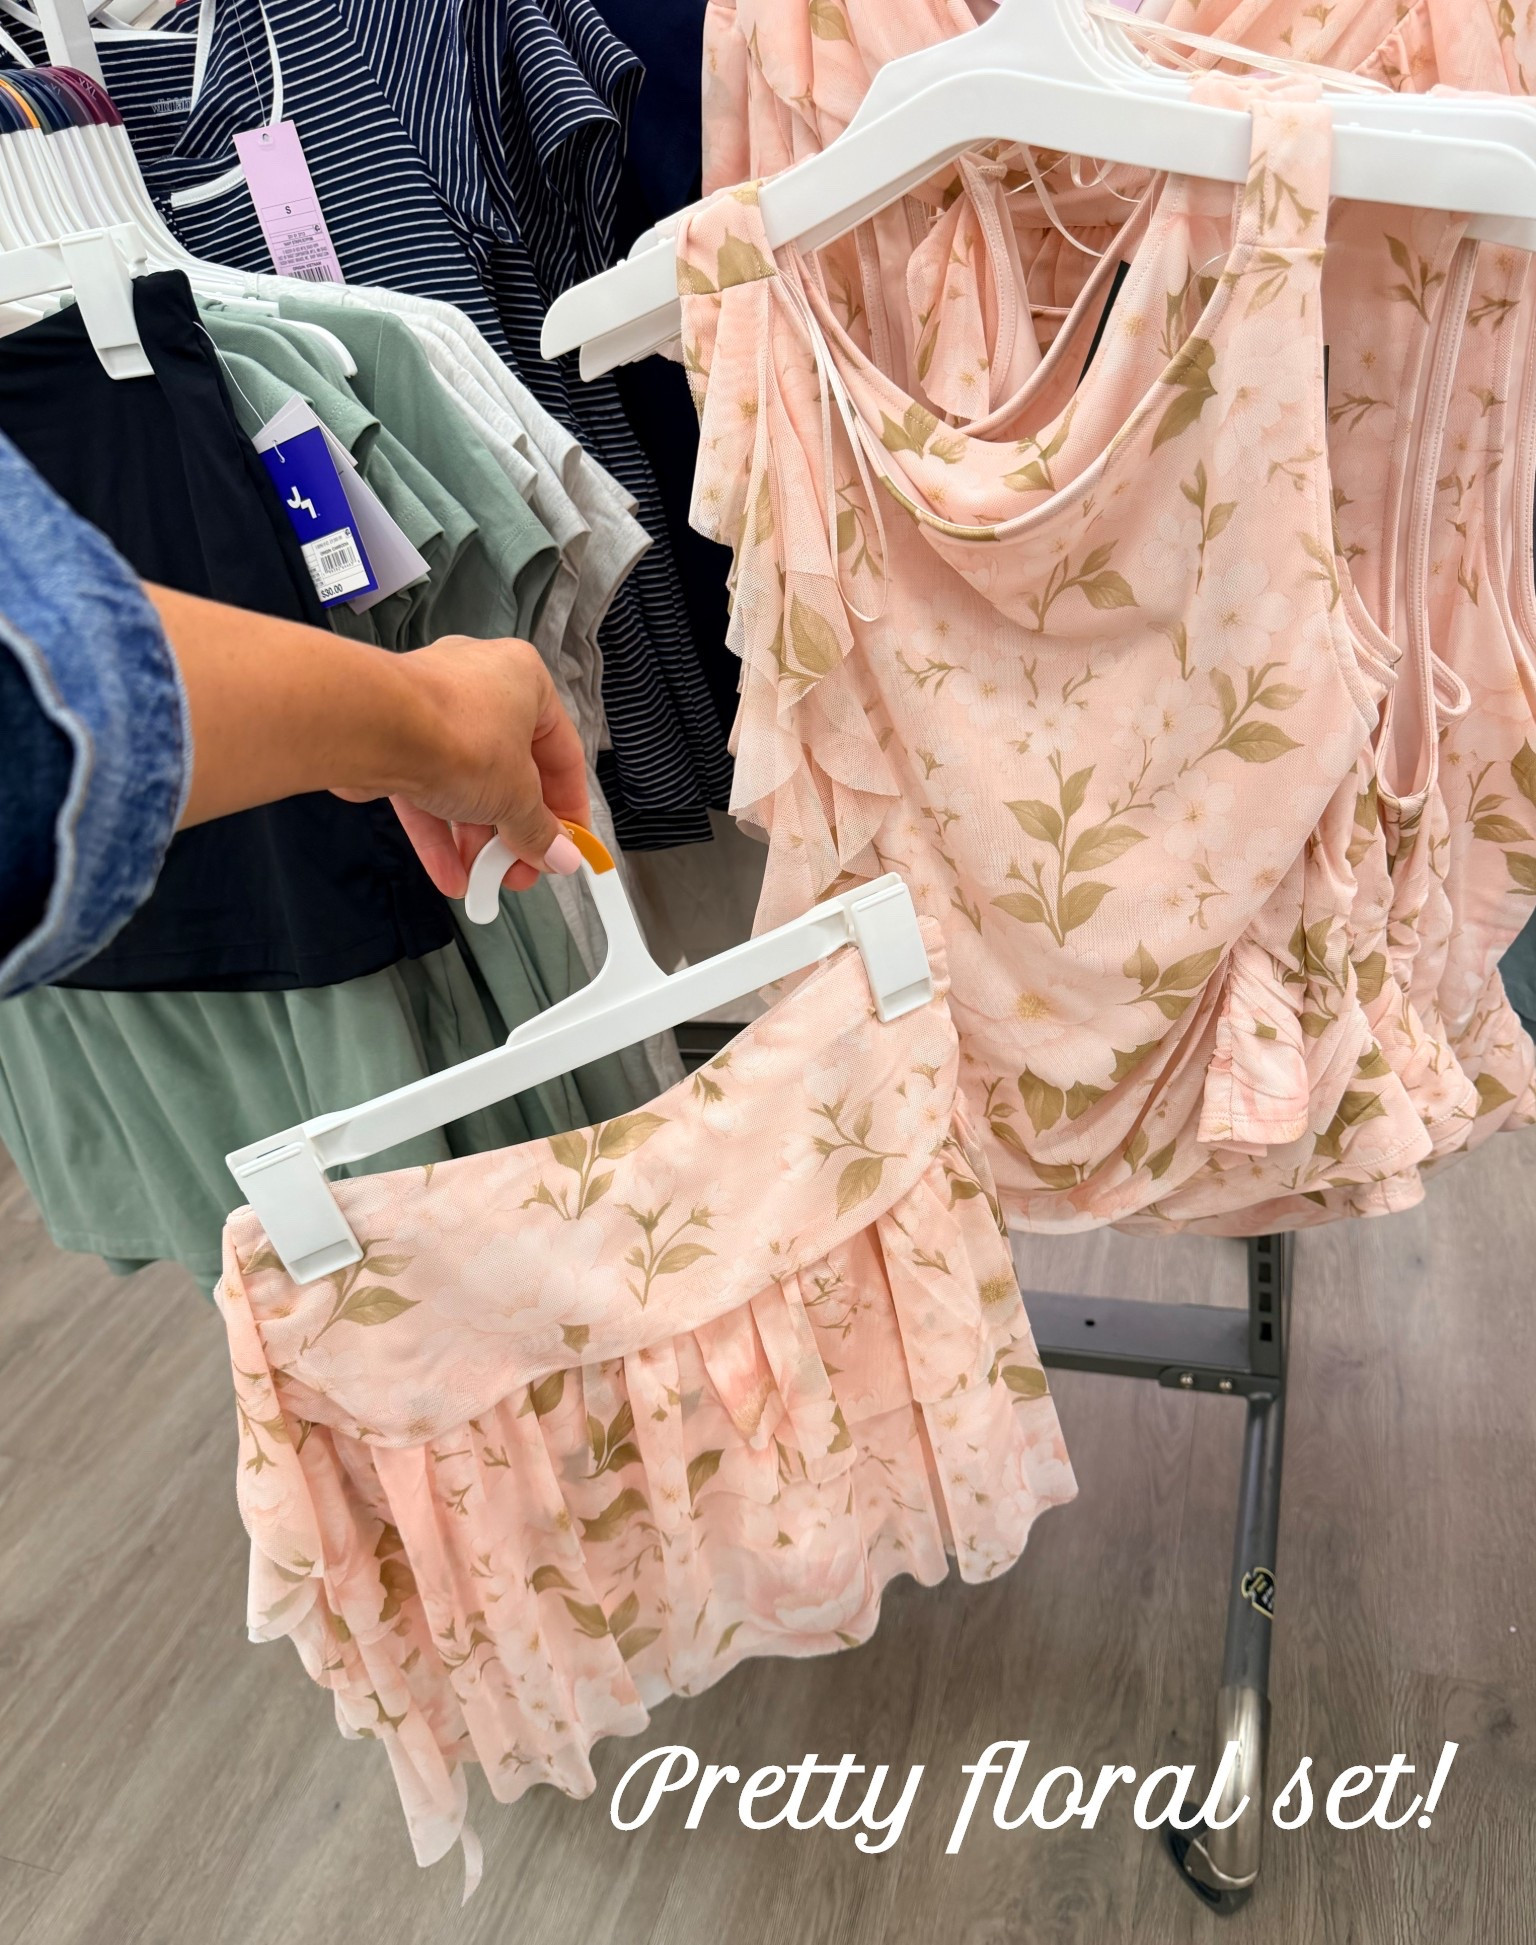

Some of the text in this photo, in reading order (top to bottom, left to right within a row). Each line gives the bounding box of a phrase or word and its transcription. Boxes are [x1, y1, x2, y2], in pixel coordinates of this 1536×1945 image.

[78, 77, 97, 101] XXL
[284, 205, 292, 215] S
[320, 583, 344, 599] $30.00
